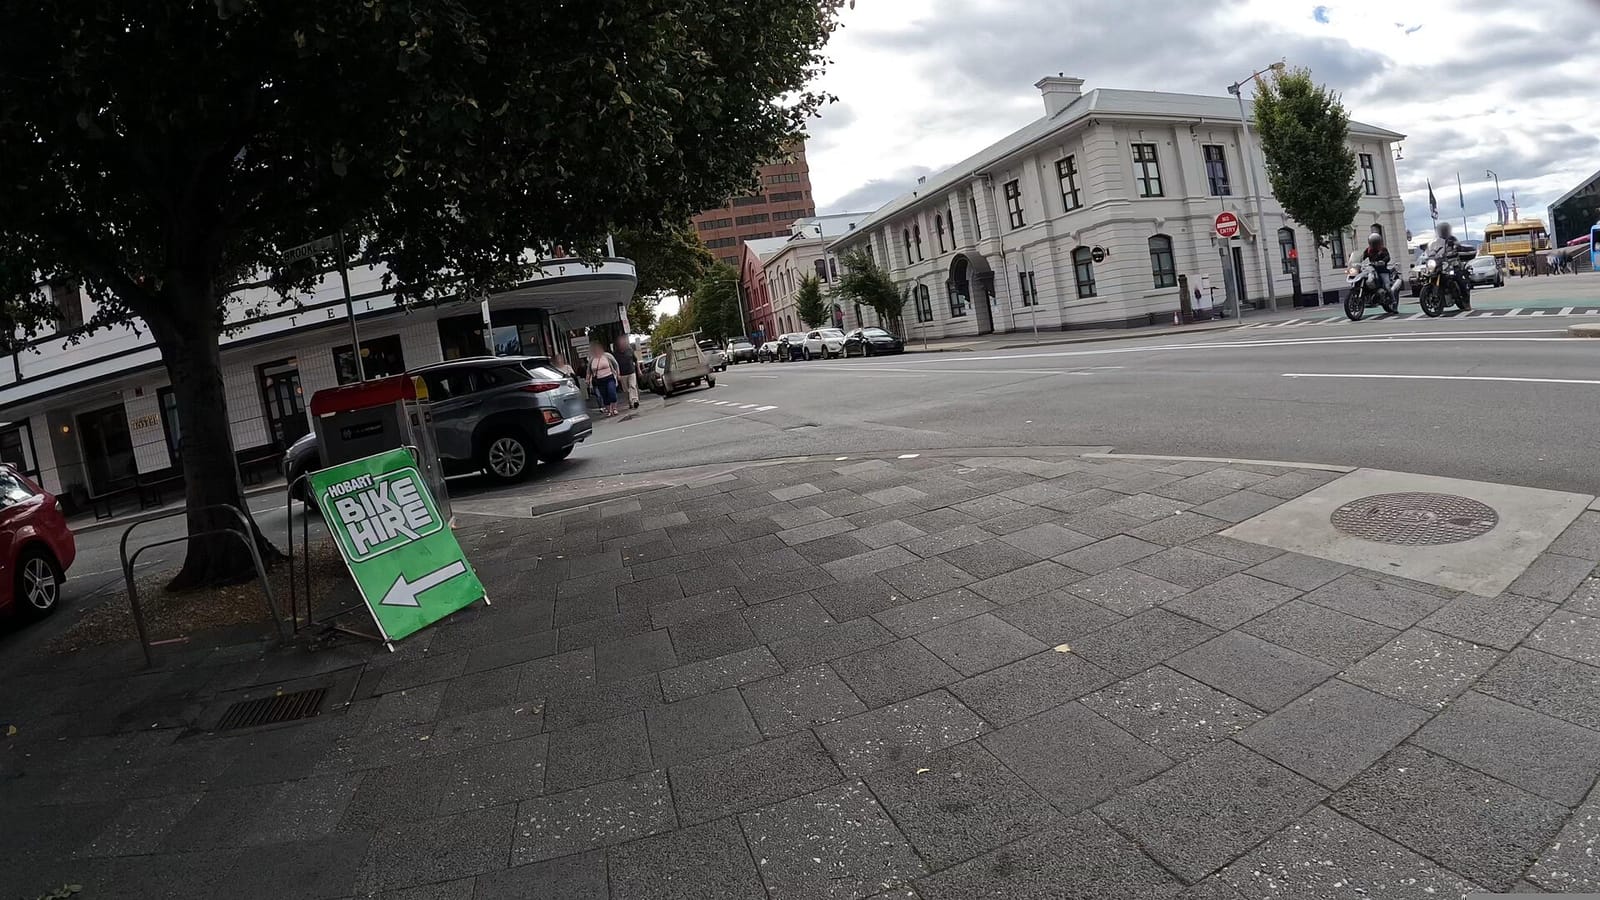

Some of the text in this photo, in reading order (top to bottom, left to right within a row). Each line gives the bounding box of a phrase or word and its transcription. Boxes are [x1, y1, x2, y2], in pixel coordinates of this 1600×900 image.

[328, 475, 373, 497] HOBART
[334, 476, 421, 524] BIKE
[345, 500, 434, 556] HIRE
